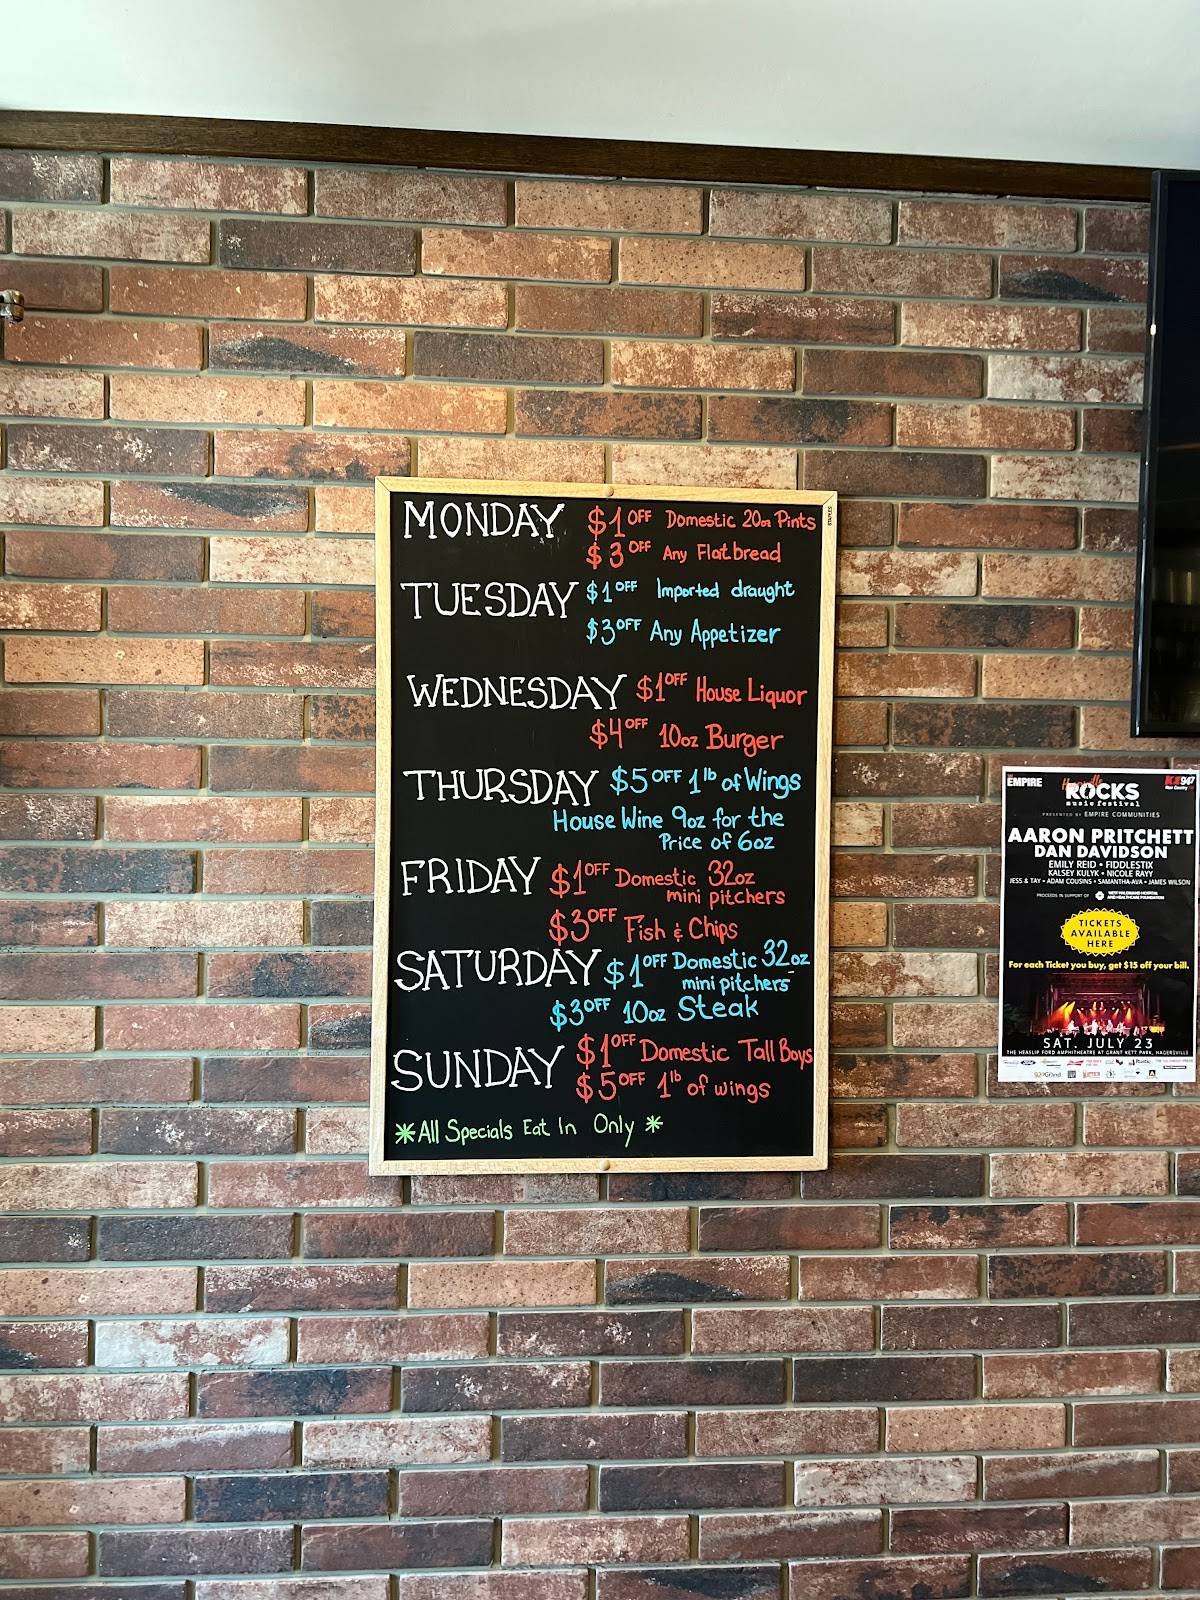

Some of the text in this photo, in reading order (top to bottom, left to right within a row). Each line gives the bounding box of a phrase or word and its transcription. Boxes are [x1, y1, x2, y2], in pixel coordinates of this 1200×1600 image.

[404, 501, 565, 539] MONDAY
[665, 510, 736, 528] Domestic
[775, 510, 816, 530] Pints
[663, 545, 687, 563] Any
[400, 582, 579, 619] TUESDAY
[657, 578, 719, 602] Imported
[731, 579, 795, 603] draught
[650, 620, 682, 646] Any
[691, 619, 781, 650] Appetizer
[407, 674, 627, 710] WEDNESDAY
[696, 676, 742, 702] House
[748, 678, 807, 709] Liquor
[659, 724, 698, 748] 10oz
[705, 724, 784, 757] Burger
[403, 768, 599, 806] THURSDAY
[722, 774, 742, 791] of
[745, 767, 801, 799] Wings
[1006, 777, 1043, 787] EMPIRE
[1065, 782, 1140, 800] ROCKS
[1097, 800, 1141, 808] festival
[553, 806, 784, 832] House Wine 9oz for the
[659, 830, 775, 851] Price of 6oz
[1007, 827, 1194, 845] AARON PRITCHETT
[1034, 845, 1168, 859] DAN DAVIDSON
[1048, 860, 1154, 869] EMILY REID FIDDLESTIX
[401, 856, 541, 896] FRIDAY
[615, 868, 696, 887] Domestic
[708, 860, 755, 886] 32oz
[1048, 869, 1154, 878] KALSEY KULYK NICOLE RAYY
[667, 888, 785, 910] mini pitchers
[624, 915, 665, 943] Fish
[674, 923, 683, 942] &
[689, 916, 737, 944] Chips
[1070, 930, 1131, 938] AVAILABLE
[1078, 919, 1122, 927] TICKETS
[672, 949, 757, 969] Domestic
[762, 939, 810, 967] 32oz
[1087, 940, 1114, 948] HERE
[394, 948, 602, 992] SATURDAY
[1008, 961, 1190, 971] For each Ticket you buy, get $15 off your bill.
[682, 971, 791, 996] mini pitchers
[623, 1001, 666, 1024] 10oz
[678, 994, 758, 1021] Steak
[639, 1039, 729, 1063] Domestic
[738, 1039, 775, 1062] Tall
[779, 1035, 815, 1073] Boys
[1043, 1037, 1154, 1049] SAT. JULY 23
[391, 1045, 565, 1091] SUNDAY
[687, 1074, 708, 1096] of
[715, 1081, 770, 1103] wings
[445, 1119, 513, 1145] Specials
[523, 1118, 550, 1136] Eat
[559, 1117, 576, 1134] In
[594, 1113, 634, 1147] Only
